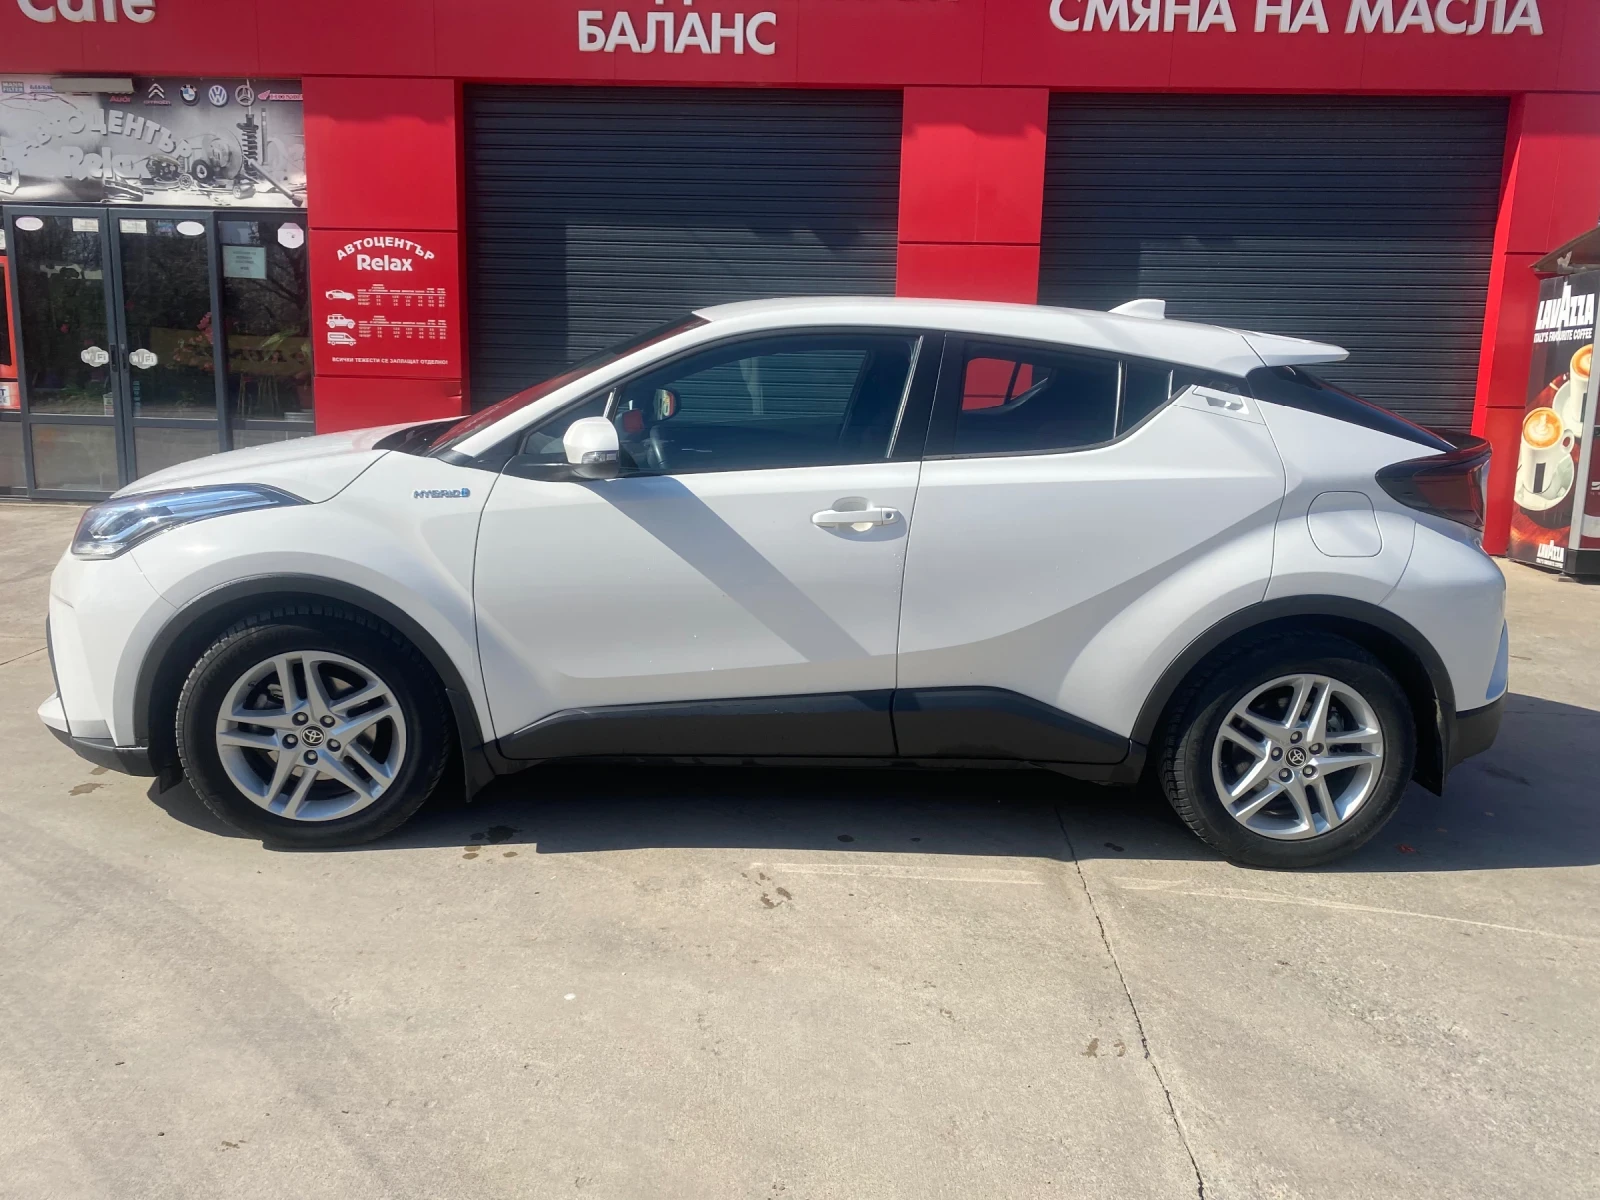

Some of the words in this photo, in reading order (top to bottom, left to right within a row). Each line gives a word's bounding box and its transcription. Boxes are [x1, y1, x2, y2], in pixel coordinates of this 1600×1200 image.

[577, 10, 777, 55] БАЛАНС
[1049, 0, 1237, 33] СМЯНА
[1254, 0, 1330, 34] НА
[1344, 0, 1544, 36] МАСЛА
[23, 108, 193, 158] ВОЦЕНТЪР
[336, 236, 435, 261] АВТОЦЕНТЪР
[356, 254, 413, 271] Relax
[1535, 283, 1595, 331] LAVAZZA
[1574, 328, 1593, 339] COFFEE
[413, 489, 460, 498] HYBRID
